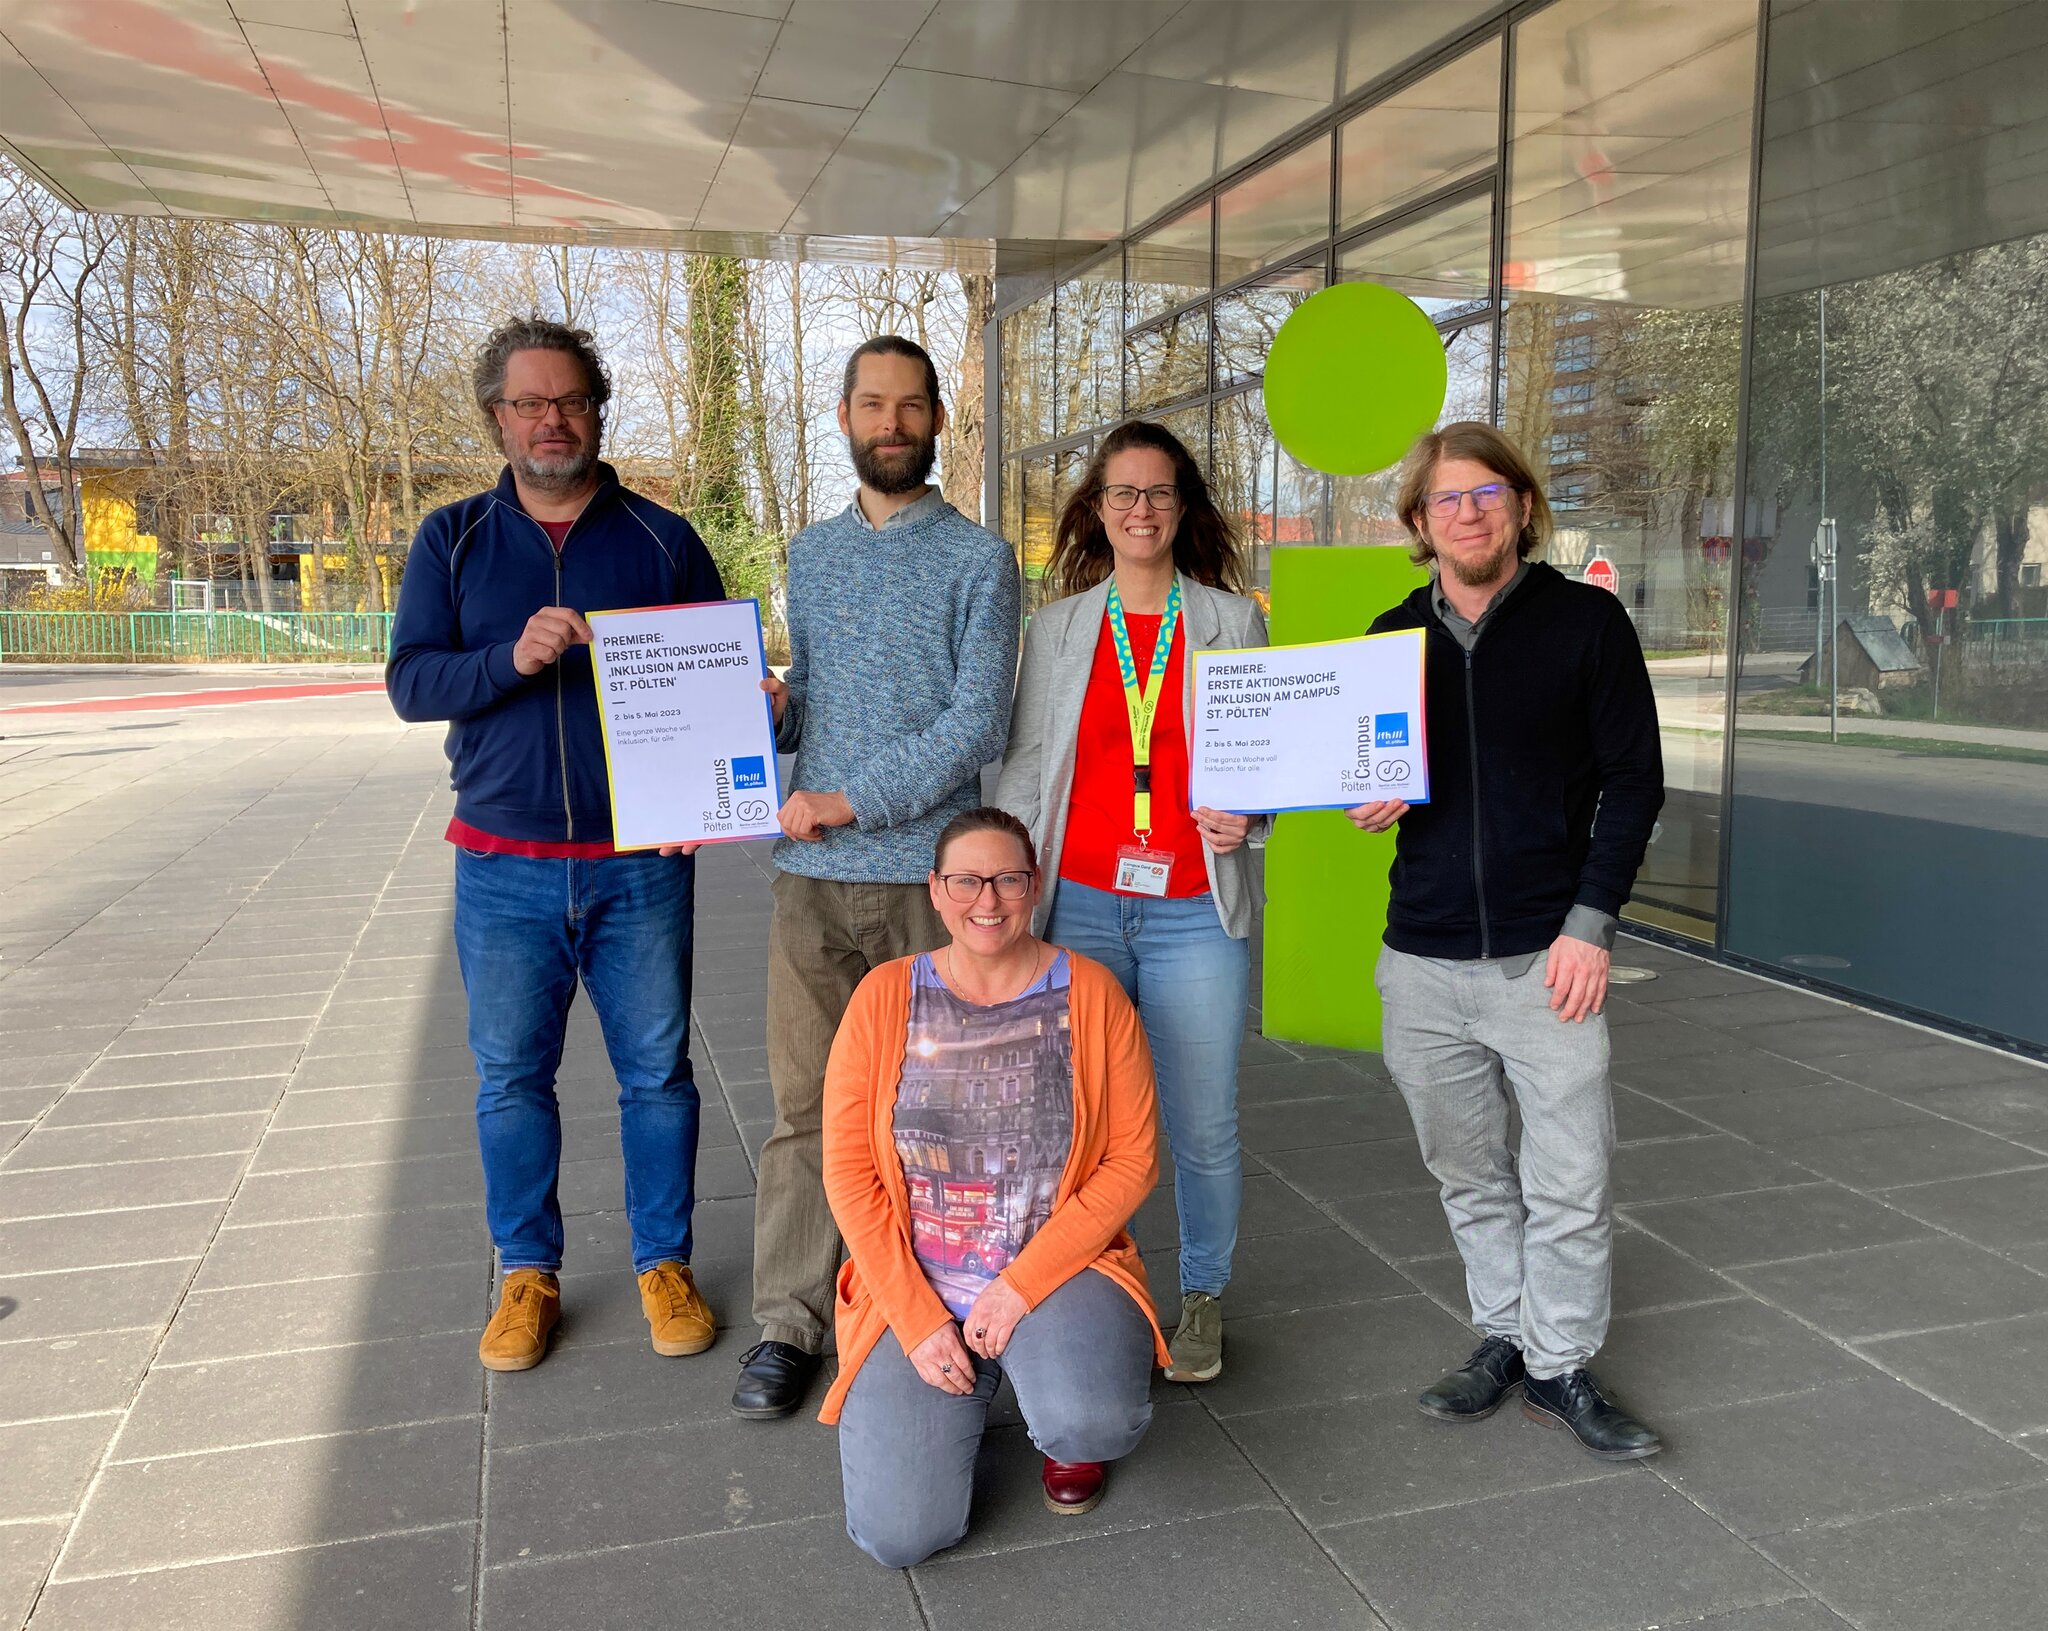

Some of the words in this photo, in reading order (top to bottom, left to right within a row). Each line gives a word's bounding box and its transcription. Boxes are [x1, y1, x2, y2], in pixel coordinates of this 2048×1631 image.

[603, 633, 664, 647] PREMIERE:
[606, 650, 642, 662] ERSTE
[646, 641, 742, 659] AKTIONSWOCHE
[678, 661, 695, 672] AM
[698, 656, 749, 669] CAMPUS
[1208, 664, 1266, 675] PREMIERE:
[610, 682, 627, 692] ST.
[1208, 679, 1243, 690] ERSTE
[1246, 671, 1336, 689] AKTIONSWOCHE
[1274, 691, 1290, 701] AM
[1294, 686, 1340, 700] CAMPUS
[1207, 709, 1223, 719] ST.
[633, 728, 653, 737] ganze
[1355, 716, 1371, 778] Campus
[714, 759, 731, 819] Campus
[1342, 782, 1371, 792] Pölten
[704, 822, 732, 832] Pölten
